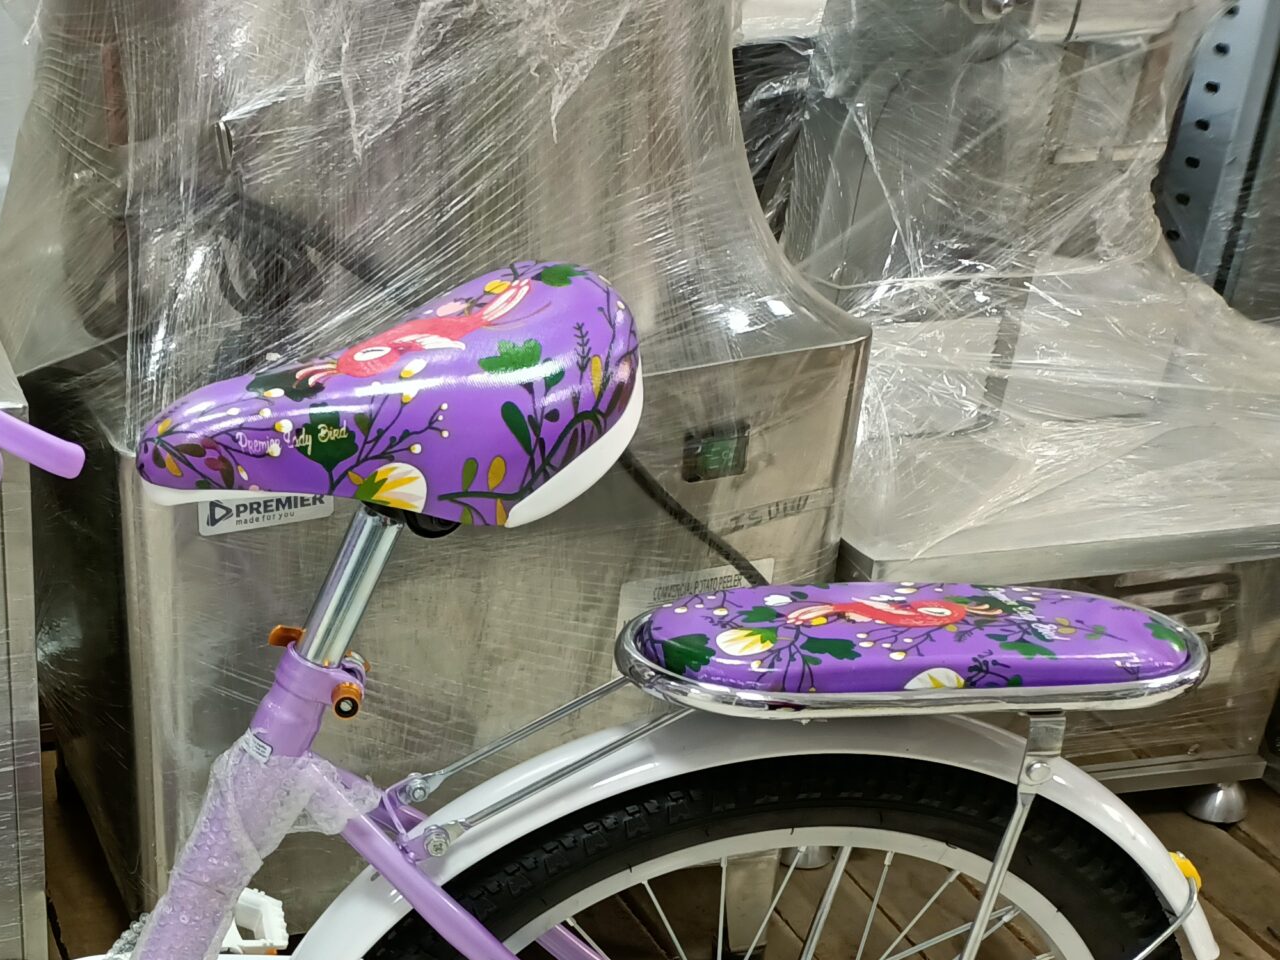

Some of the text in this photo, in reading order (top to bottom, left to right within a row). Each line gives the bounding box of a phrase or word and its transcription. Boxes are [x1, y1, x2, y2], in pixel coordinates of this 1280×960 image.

[317, 419, 349, 443] Bird
[235, 494, 325, 518] PREMIER
[235, 511, 295, 526] made for you
[694, 577, 718, 594] POTATO
[719, 573, 742, 589] PEELER
